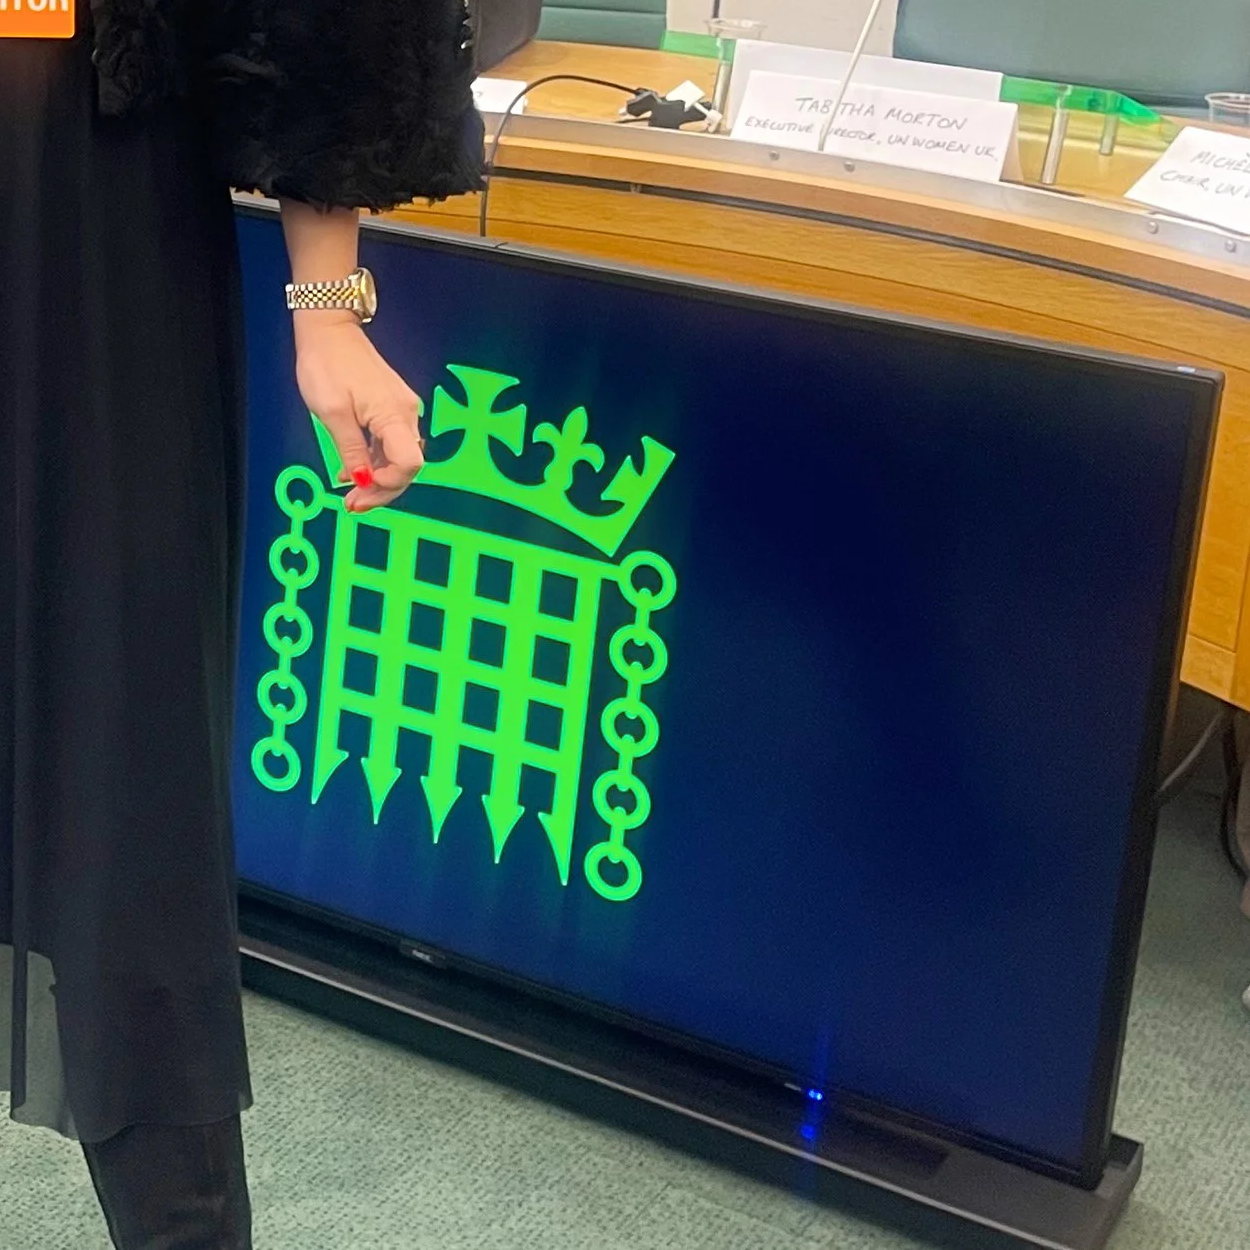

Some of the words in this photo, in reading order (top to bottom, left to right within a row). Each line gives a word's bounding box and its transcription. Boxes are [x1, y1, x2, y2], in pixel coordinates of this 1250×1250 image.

[795, 96, 875, 118] TABTHA
[884, 107, 969, 131] MORTON
[744, 115, 814, 134] EXECUTIVE
[887, 134, 909, 146] UN
[913, 136, 970, 154] WOMEN
[1214, 182, 1244, 197] UN
